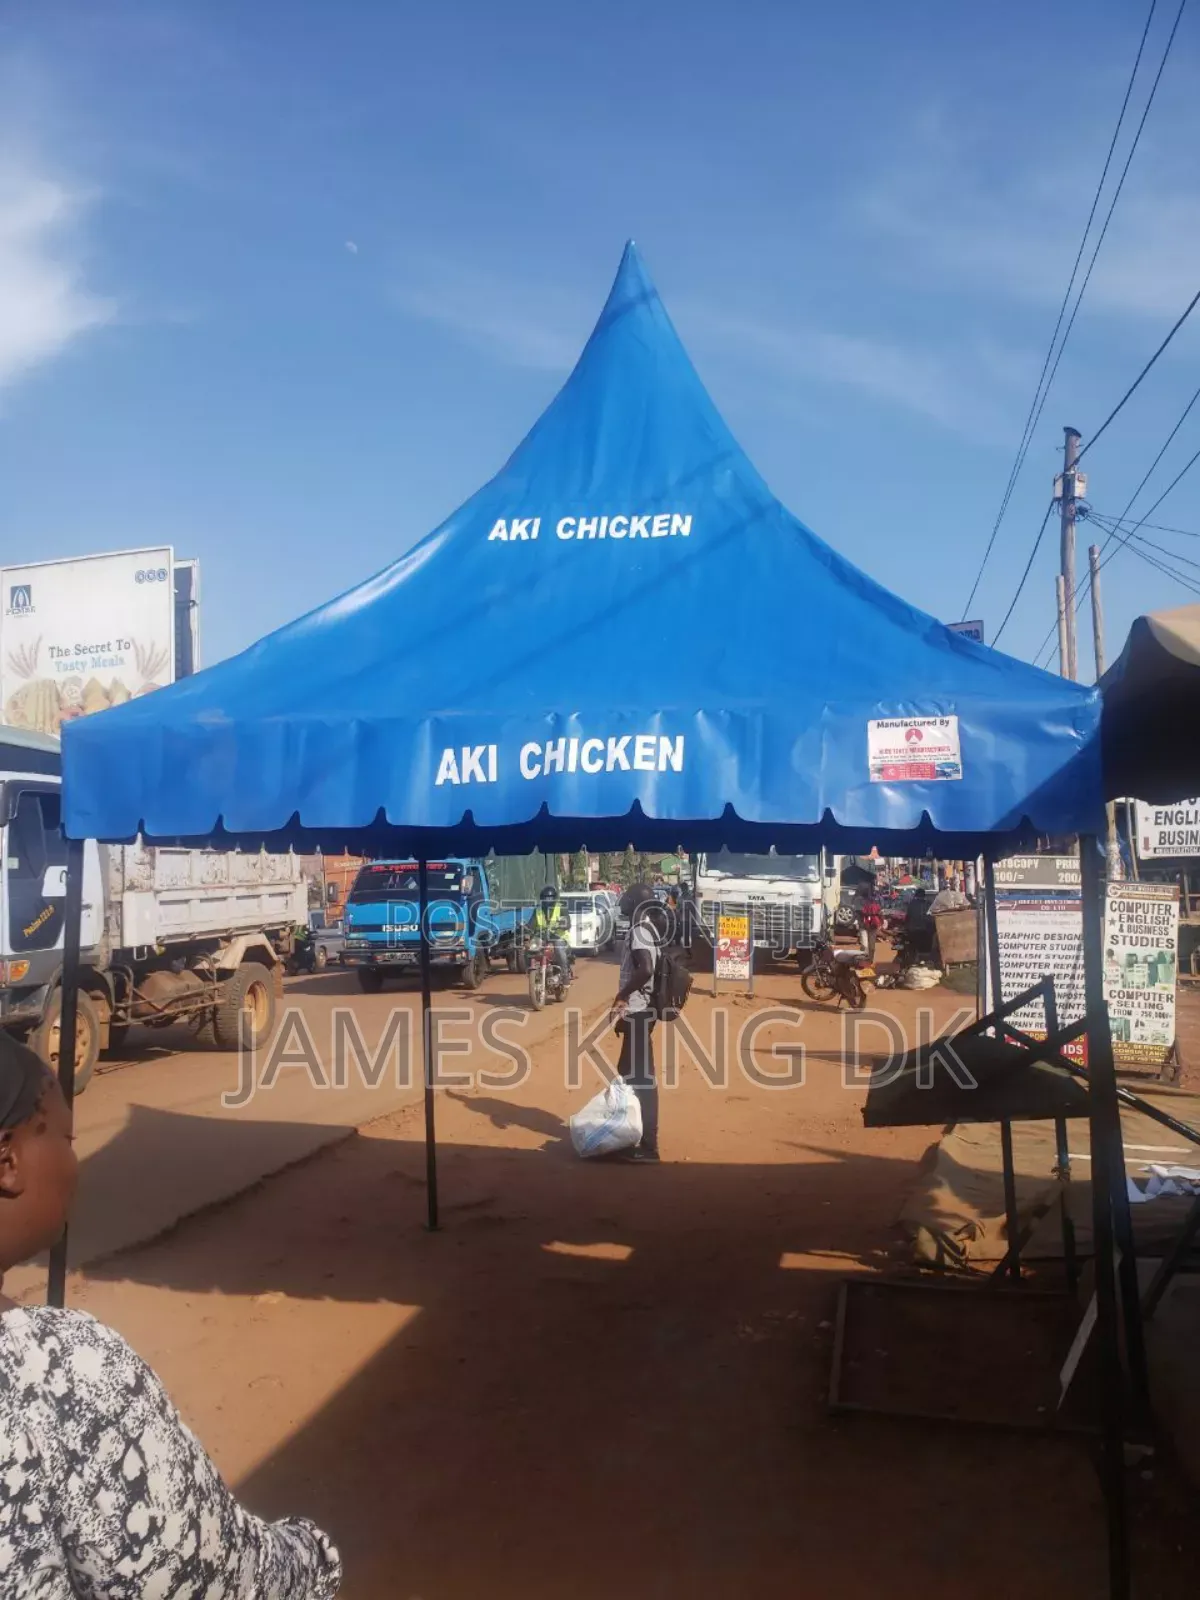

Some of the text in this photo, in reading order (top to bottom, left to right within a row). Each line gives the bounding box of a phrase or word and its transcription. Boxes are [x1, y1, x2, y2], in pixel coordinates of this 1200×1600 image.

[488, 514, 693, 541] AKI CHICKEN
[48, 639, 131, 658] The Secret To
[54, 655, 126, 673] Tasty Meals
[877, 719, 950, 729] Manufactured By
[435, 735, 685, 786] AKI CHICKEN
[1154, 810, 1200, 826] ENGLI
[1159, 830, 1200, 846] BUSIN
[1055, 859, 1081, 870] PRIN
[1058, 872, 1082, 883] 200/
[382, 924, 419, 932] ISUZU
[1126, 924, 1170, 936] BUSINESS
[998, 931, 1083, 941] GRAPHIC DESIGN
[1109, 934, 1175, 950] STUDIES
[999, 942, 1083, 951] COMPUTER STUDIE
[1044, 953, 1083, 961] STUDIE
[1000, 961, 1050, 970] COMPUTER
[1109, 989, 1175, 1004] COMPUTER
[1116, 999, 1165, 1011] SELLING
[1113, 1008, 1133, 1017] FROM
